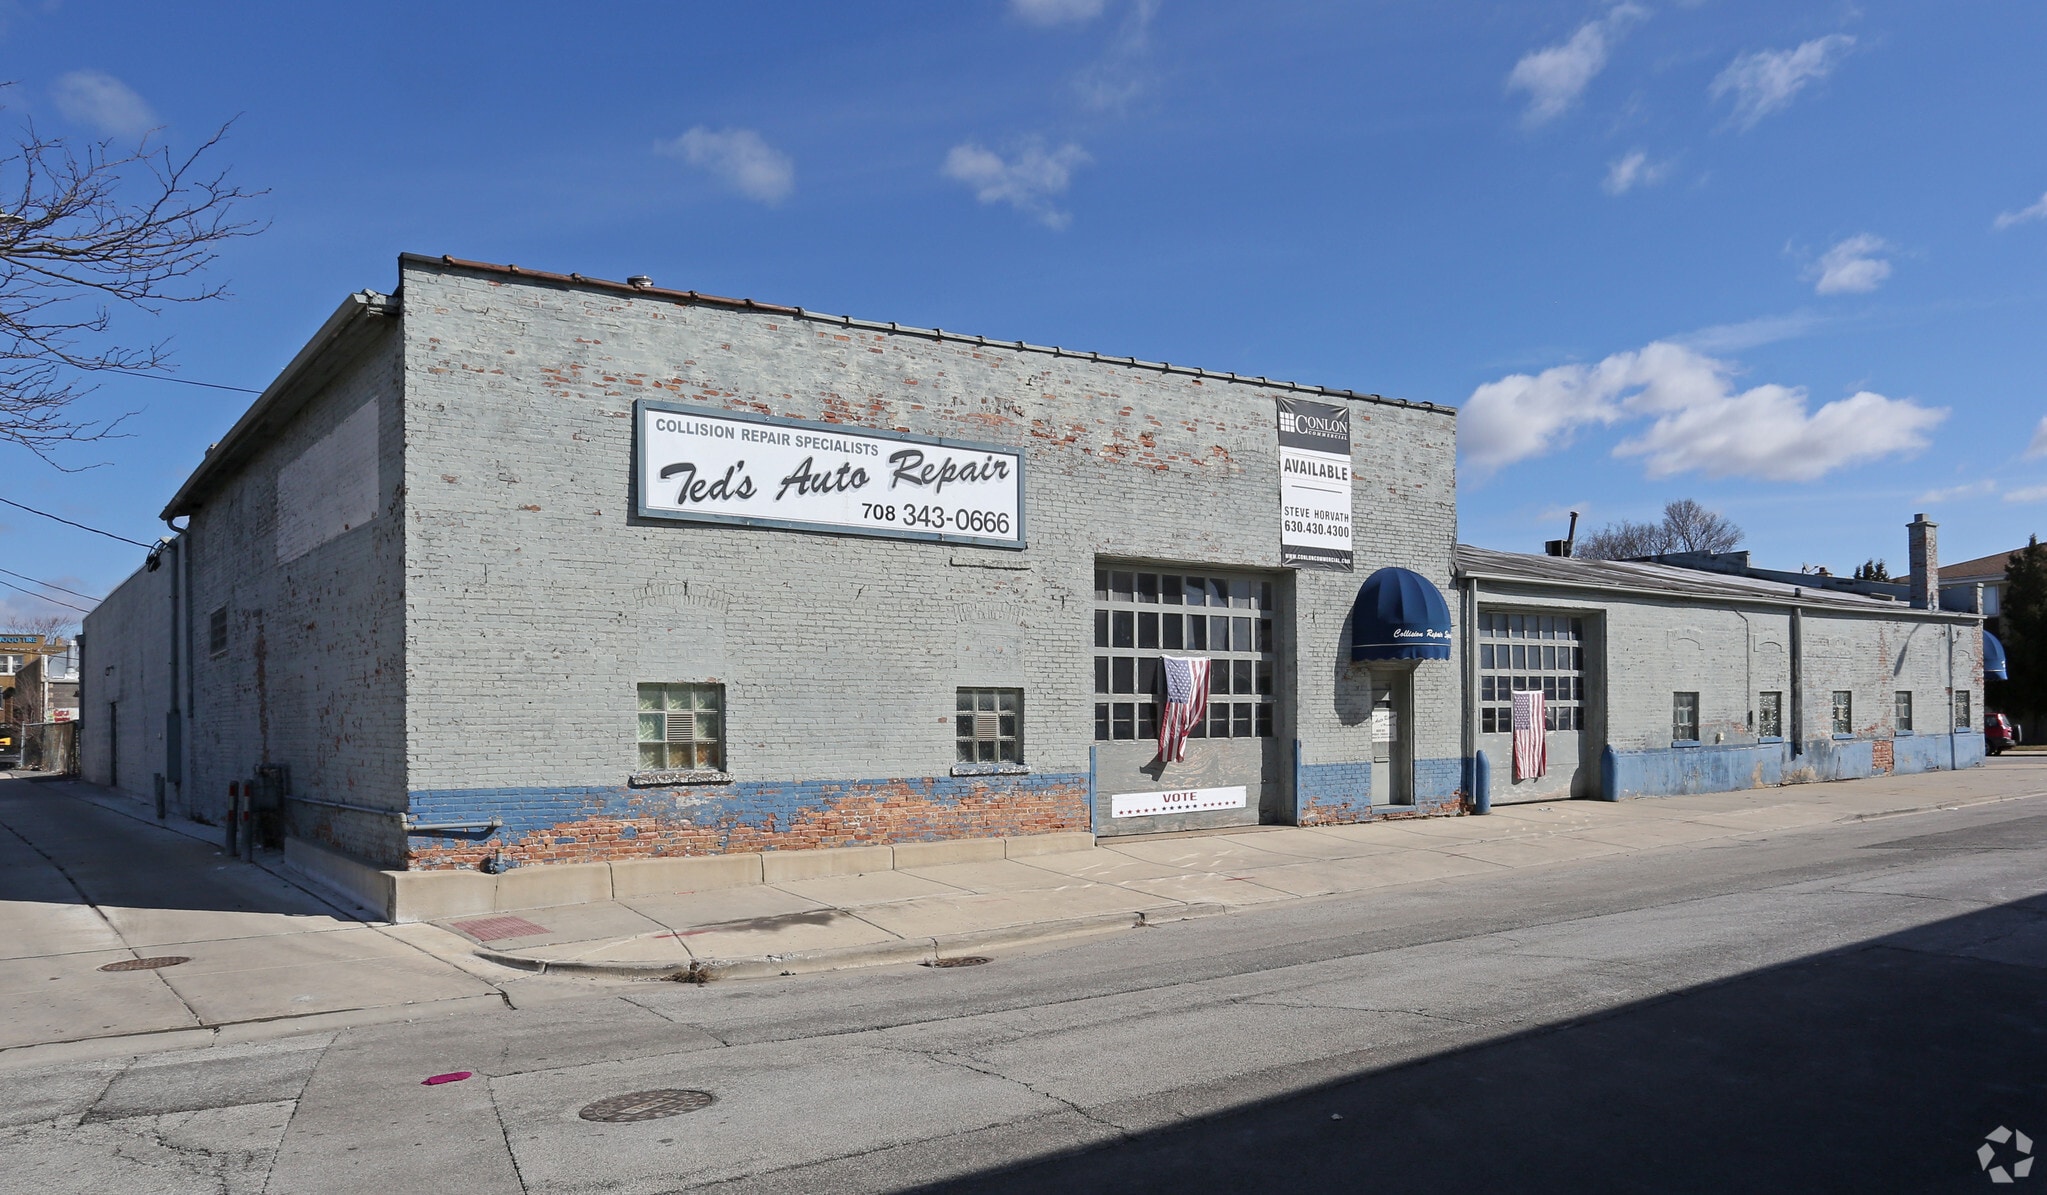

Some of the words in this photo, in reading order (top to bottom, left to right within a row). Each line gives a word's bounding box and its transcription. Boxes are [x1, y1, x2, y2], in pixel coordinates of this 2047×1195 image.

[1295, 414, 1348, 435] CONLON
[655, 418, 735, 440] COLLISION
[741, 428, 791, 447] REPAIR
[795, 435, 879, 457] SPECIALISTS
[1308, 430, 1348, 441] COMMERCIAL
[660, 460, 757, 505] Ted's
[775, 456, 870, 501] Auto
[888, 449, 1010, 493] Repair
[1284, 458, 1348, 481] AVAILABLE
[861, 502, 896, 522] 708
[902, 503, 1010, 534] 343-0666
[1284, 506, 1310, 518] STEVE
[1314, 510, 1349, 523] HORVATH
[1284, 520, 1349, 538] 630.430.4300
[1393, 628, 1424, 638] Collision
[1163, 792, 1198, 803] VOTE
